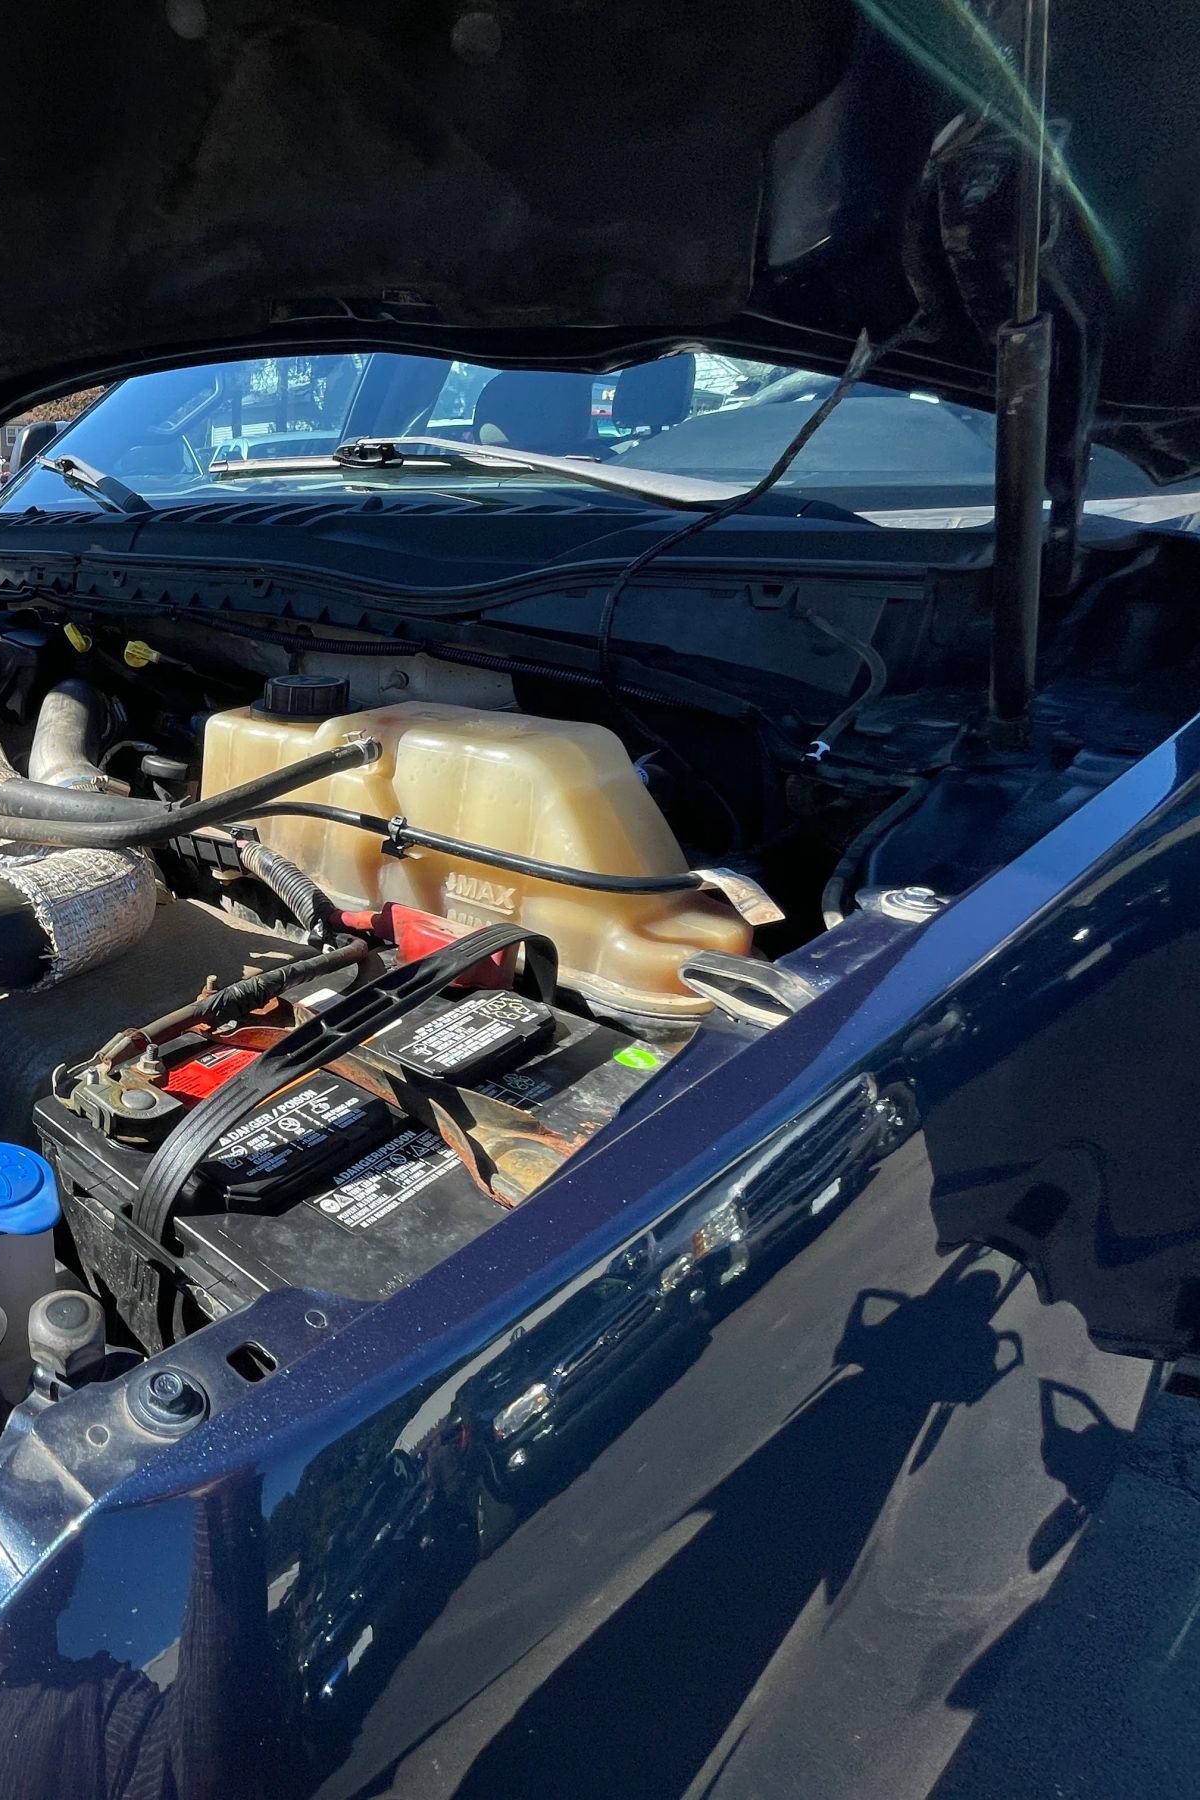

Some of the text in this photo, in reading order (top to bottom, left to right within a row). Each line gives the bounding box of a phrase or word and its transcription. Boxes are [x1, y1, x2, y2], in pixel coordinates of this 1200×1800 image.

[456, 874, 516, 909] MAX
[227, 1114, 275, 1141] DANGER
[278, 1090, 318, 1113] POISON
